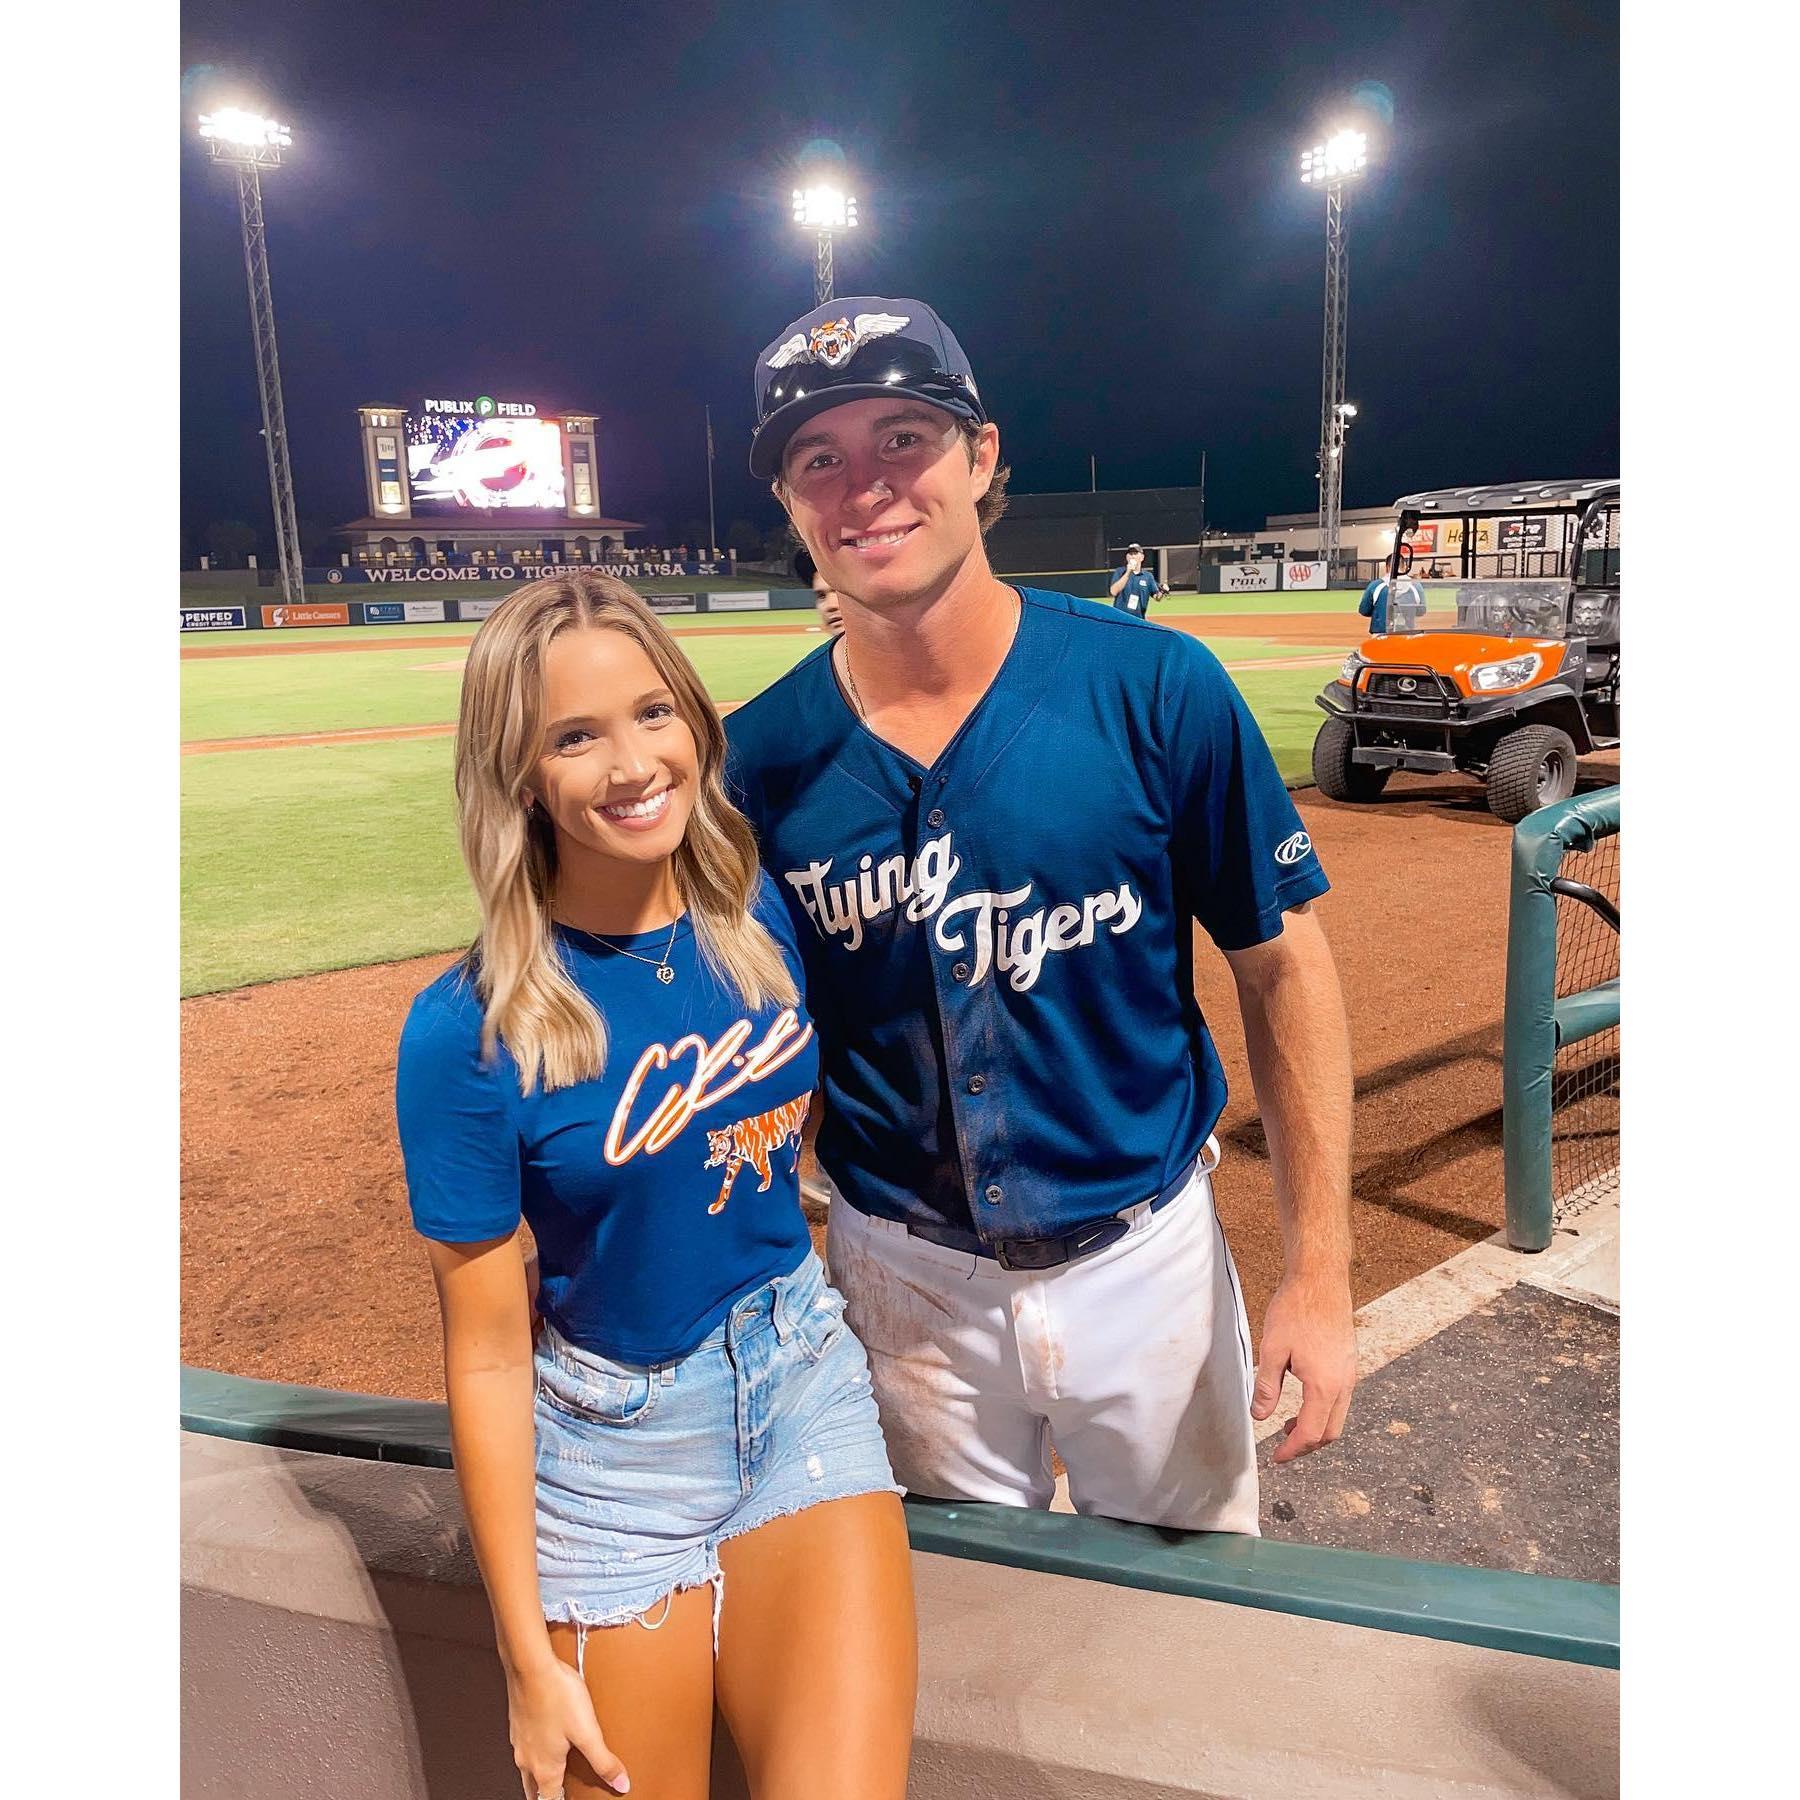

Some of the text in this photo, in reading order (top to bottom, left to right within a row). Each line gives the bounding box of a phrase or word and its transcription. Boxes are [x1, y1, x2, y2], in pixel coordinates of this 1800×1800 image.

[425, 400, 474, 413] PUBLIX
[498, 403, 536, 416] FIELD
[1447, 529, 1488, 543] Hez
[365, 563, 686, 582] WELCOME TO TIGEWN USA
[185, 612, 232, 622] PENFED
[784, 832, 960, 952] Flying
[934, 882, 1142, 992] Tigers
